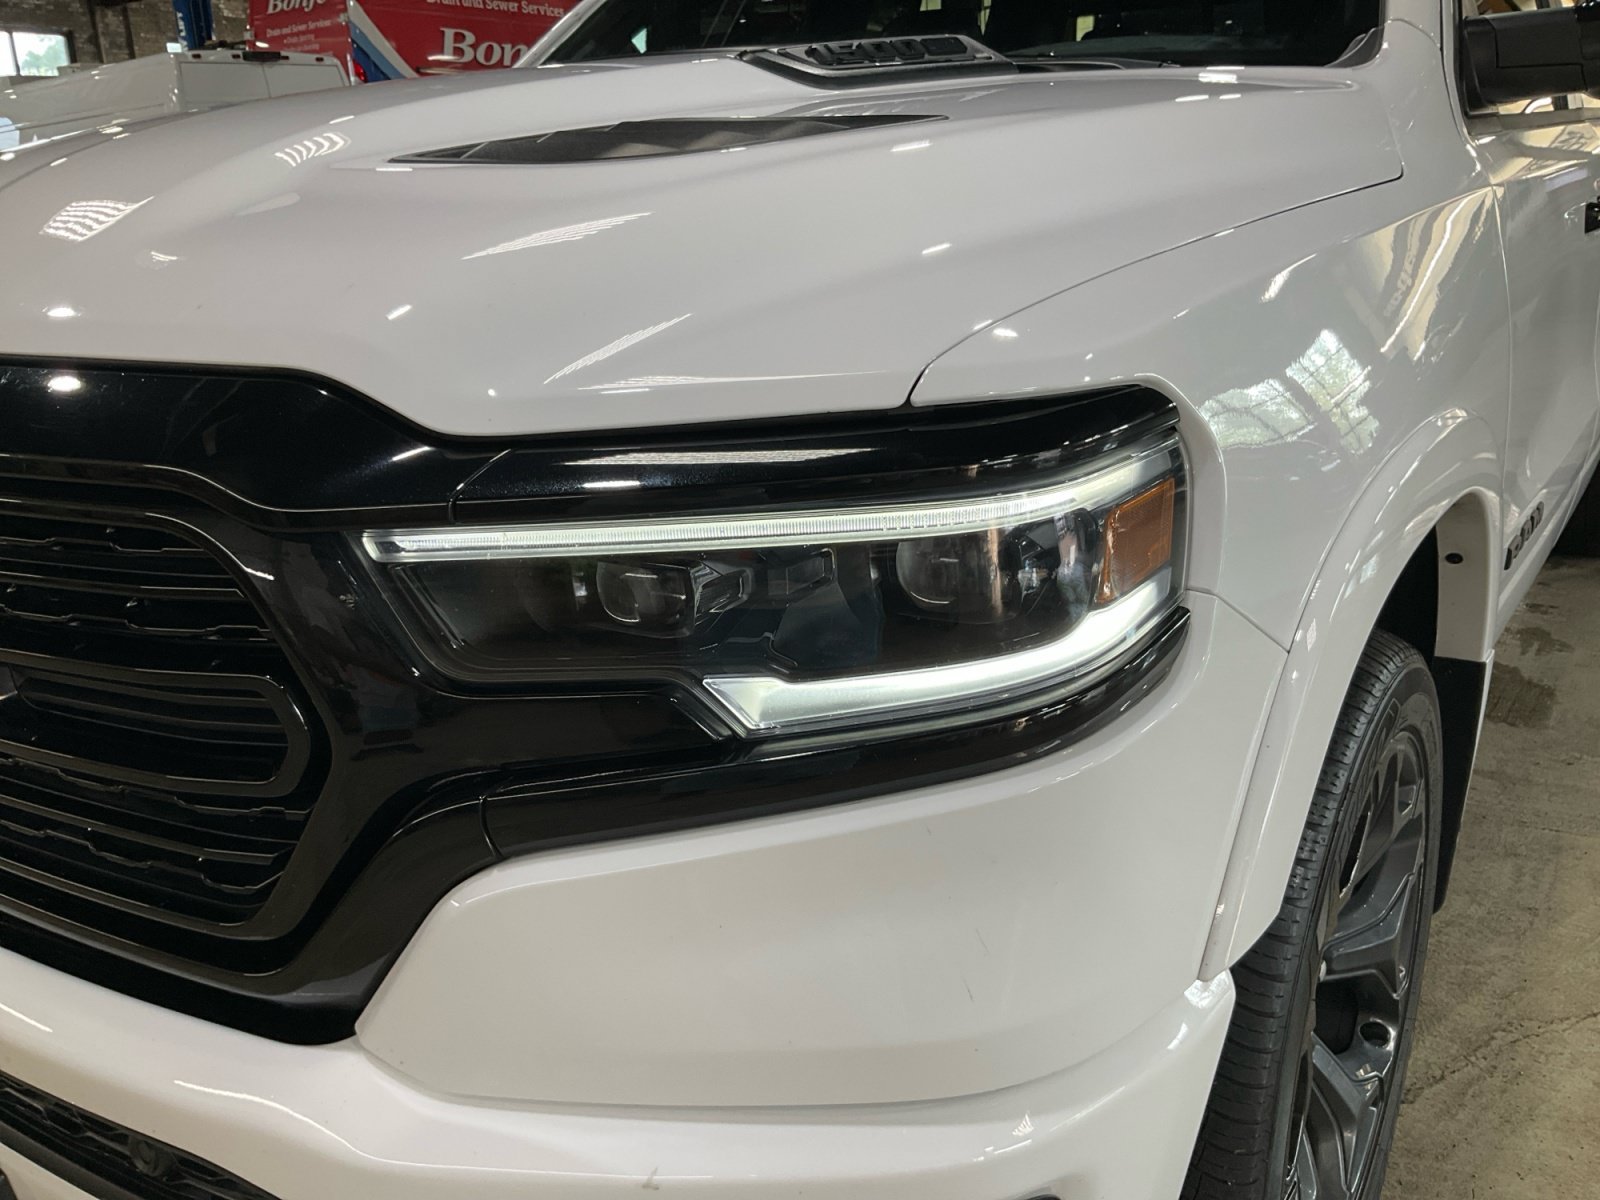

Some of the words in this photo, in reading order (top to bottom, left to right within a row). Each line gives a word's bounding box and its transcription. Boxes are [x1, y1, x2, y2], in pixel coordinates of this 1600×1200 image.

[266, 0, 326, 14] Bon
[462, 0, 484, 9] and
[485, 0, 518, 13] Sewer
[521, 1, 566, 17] Services
